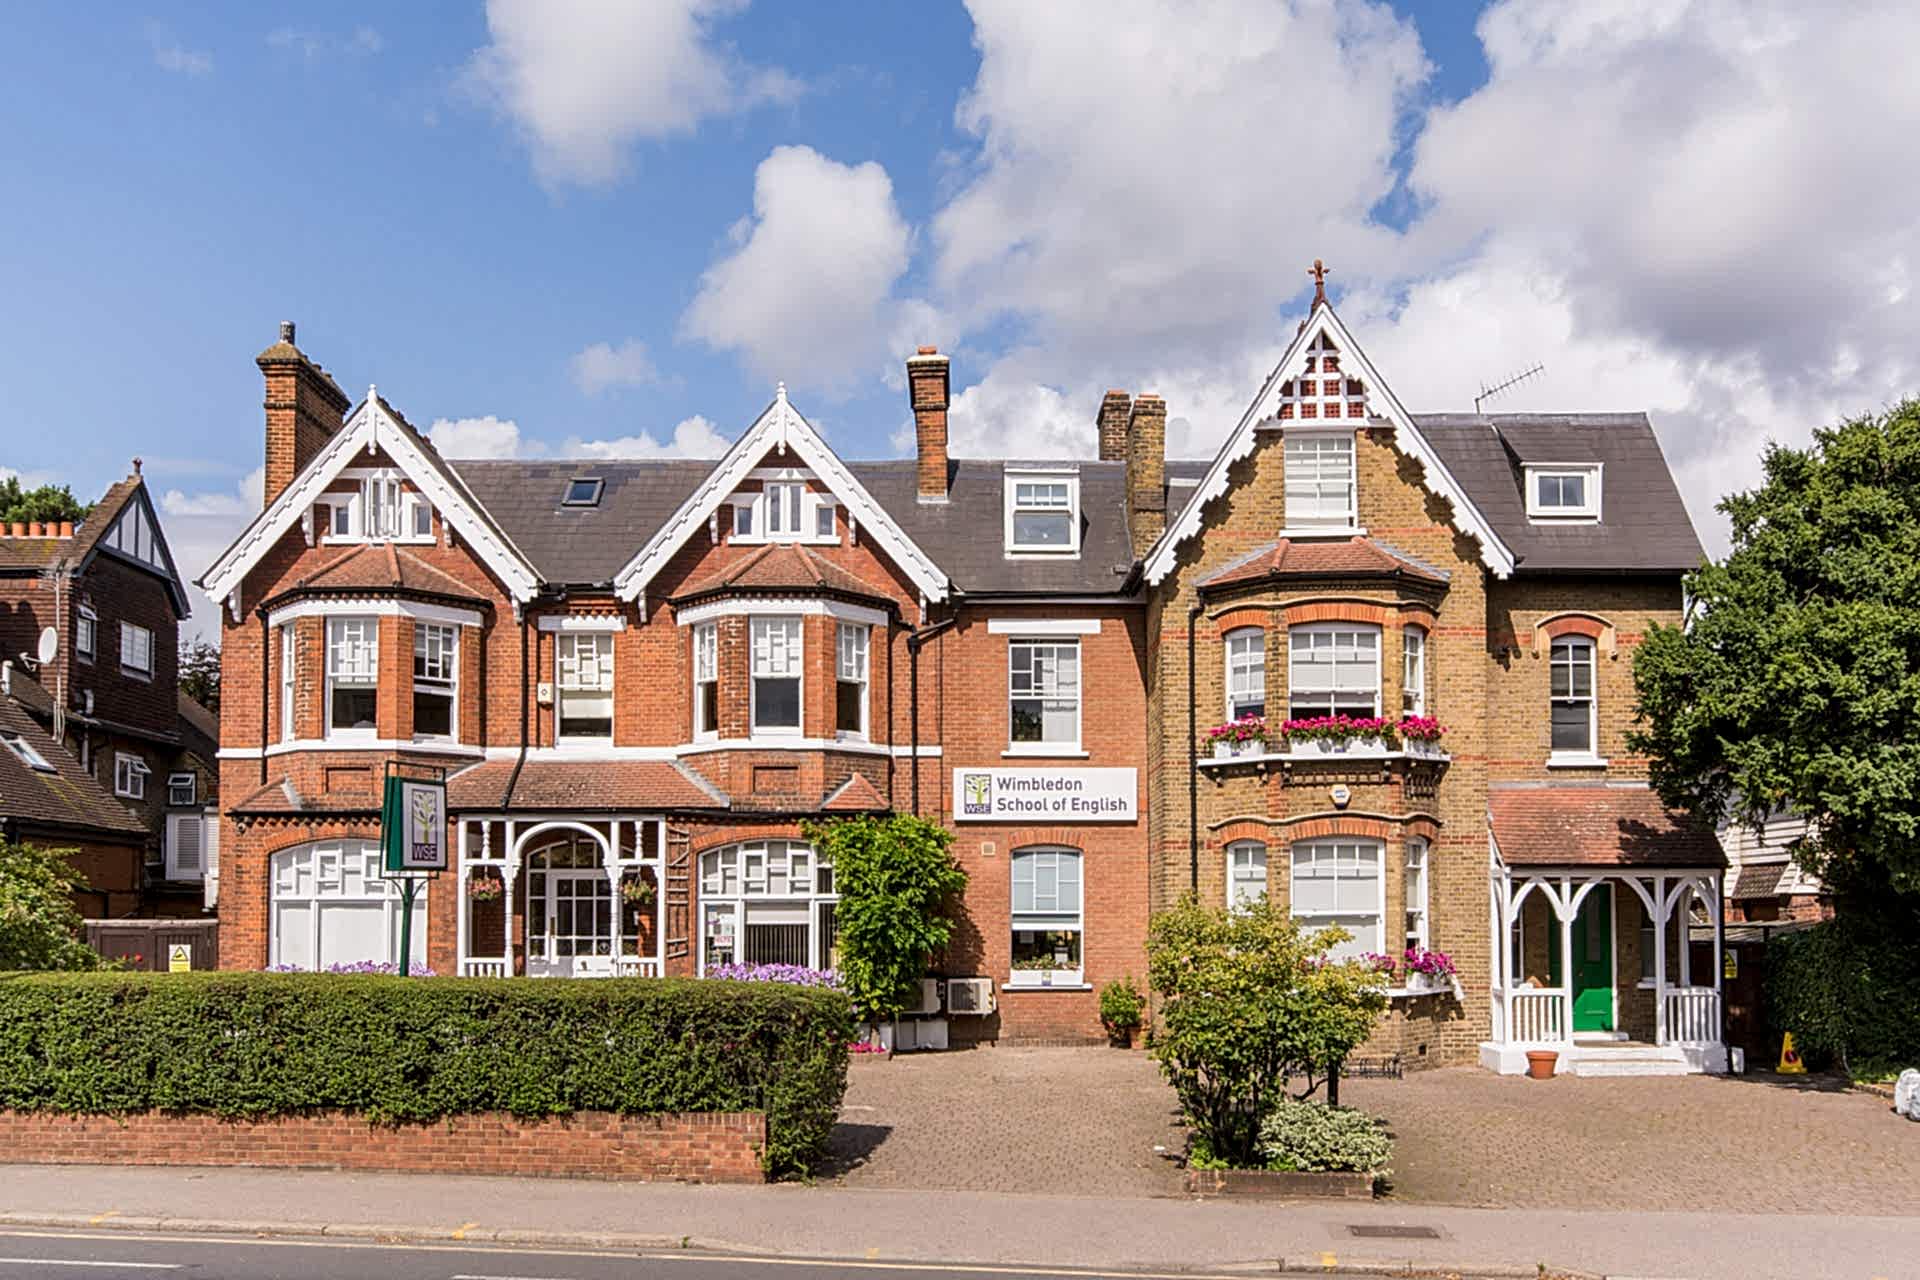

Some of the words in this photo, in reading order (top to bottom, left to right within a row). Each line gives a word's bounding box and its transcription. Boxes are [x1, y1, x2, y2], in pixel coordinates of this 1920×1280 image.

[997, 777, 1083, 791] Wimbledon
[965, 804, 991, 813] WSE
[997, 797, 1048, 811] School
[1052, 797, 1066, 811] of
[1071, 797, 1128, 814] English
[413, 844, 437, 860] WSE
